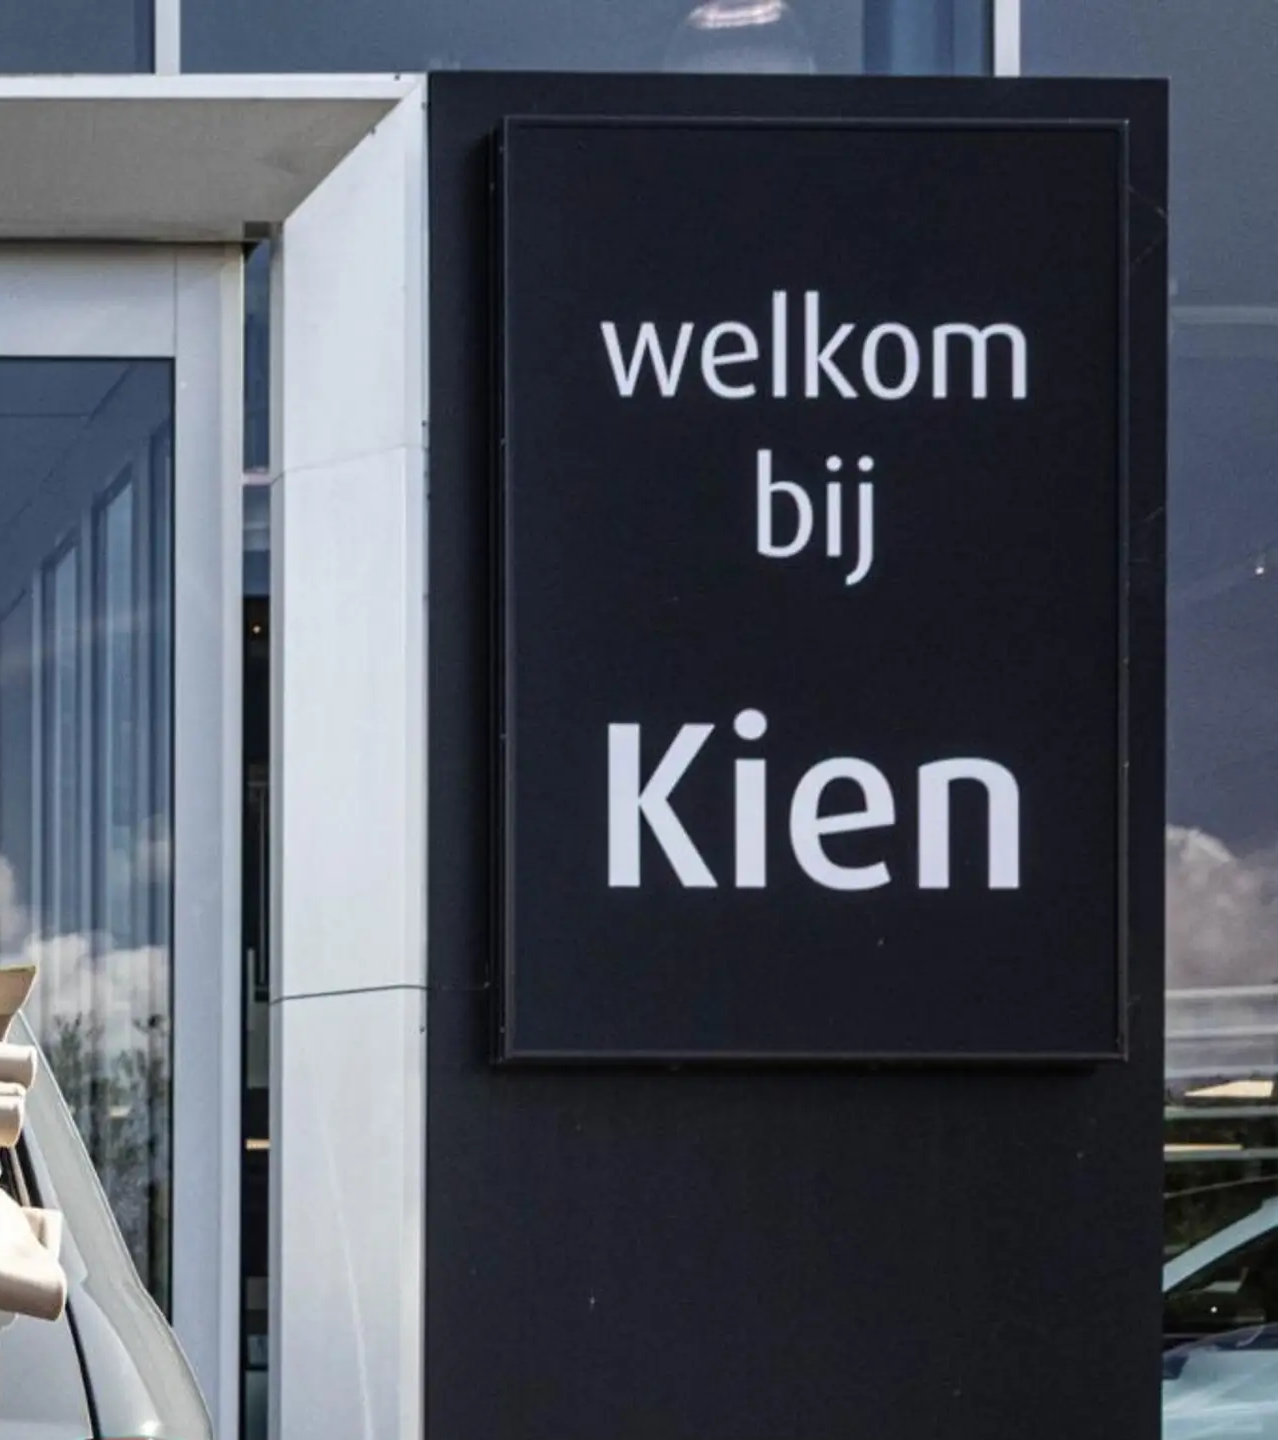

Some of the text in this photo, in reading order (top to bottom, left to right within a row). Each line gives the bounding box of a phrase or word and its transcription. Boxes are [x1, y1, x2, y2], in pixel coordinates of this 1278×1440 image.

[600, 290, 1027, 400] welkom
[757, 448, 874, 586] bij
[607, 708, 1020, 891] Kien
